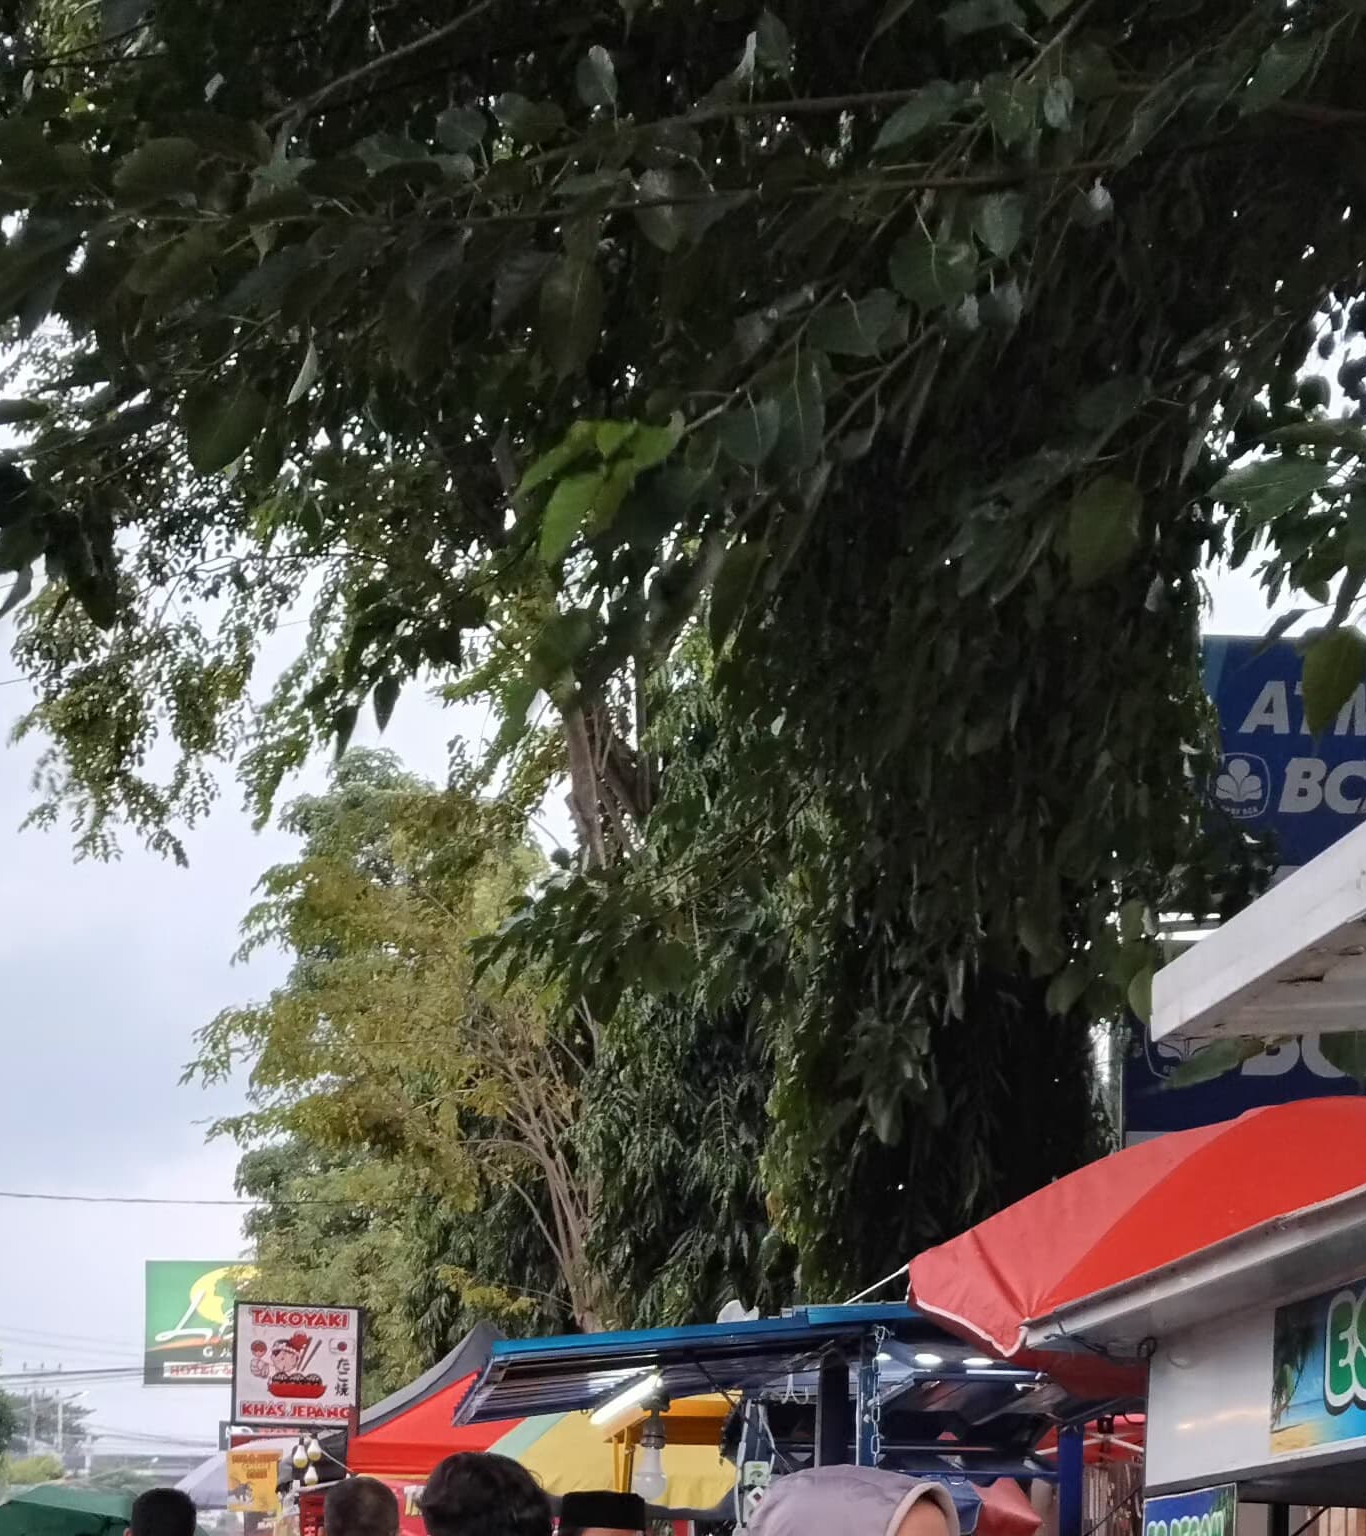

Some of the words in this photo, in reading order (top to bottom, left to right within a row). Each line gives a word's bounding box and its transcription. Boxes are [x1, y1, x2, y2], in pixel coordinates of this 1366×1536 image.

[250, 1307, 349, 1328] TAKOYAKI
[241, 1403, 284, 1418] KHAS
[291, 1404, 350, 1419] JEPANG
